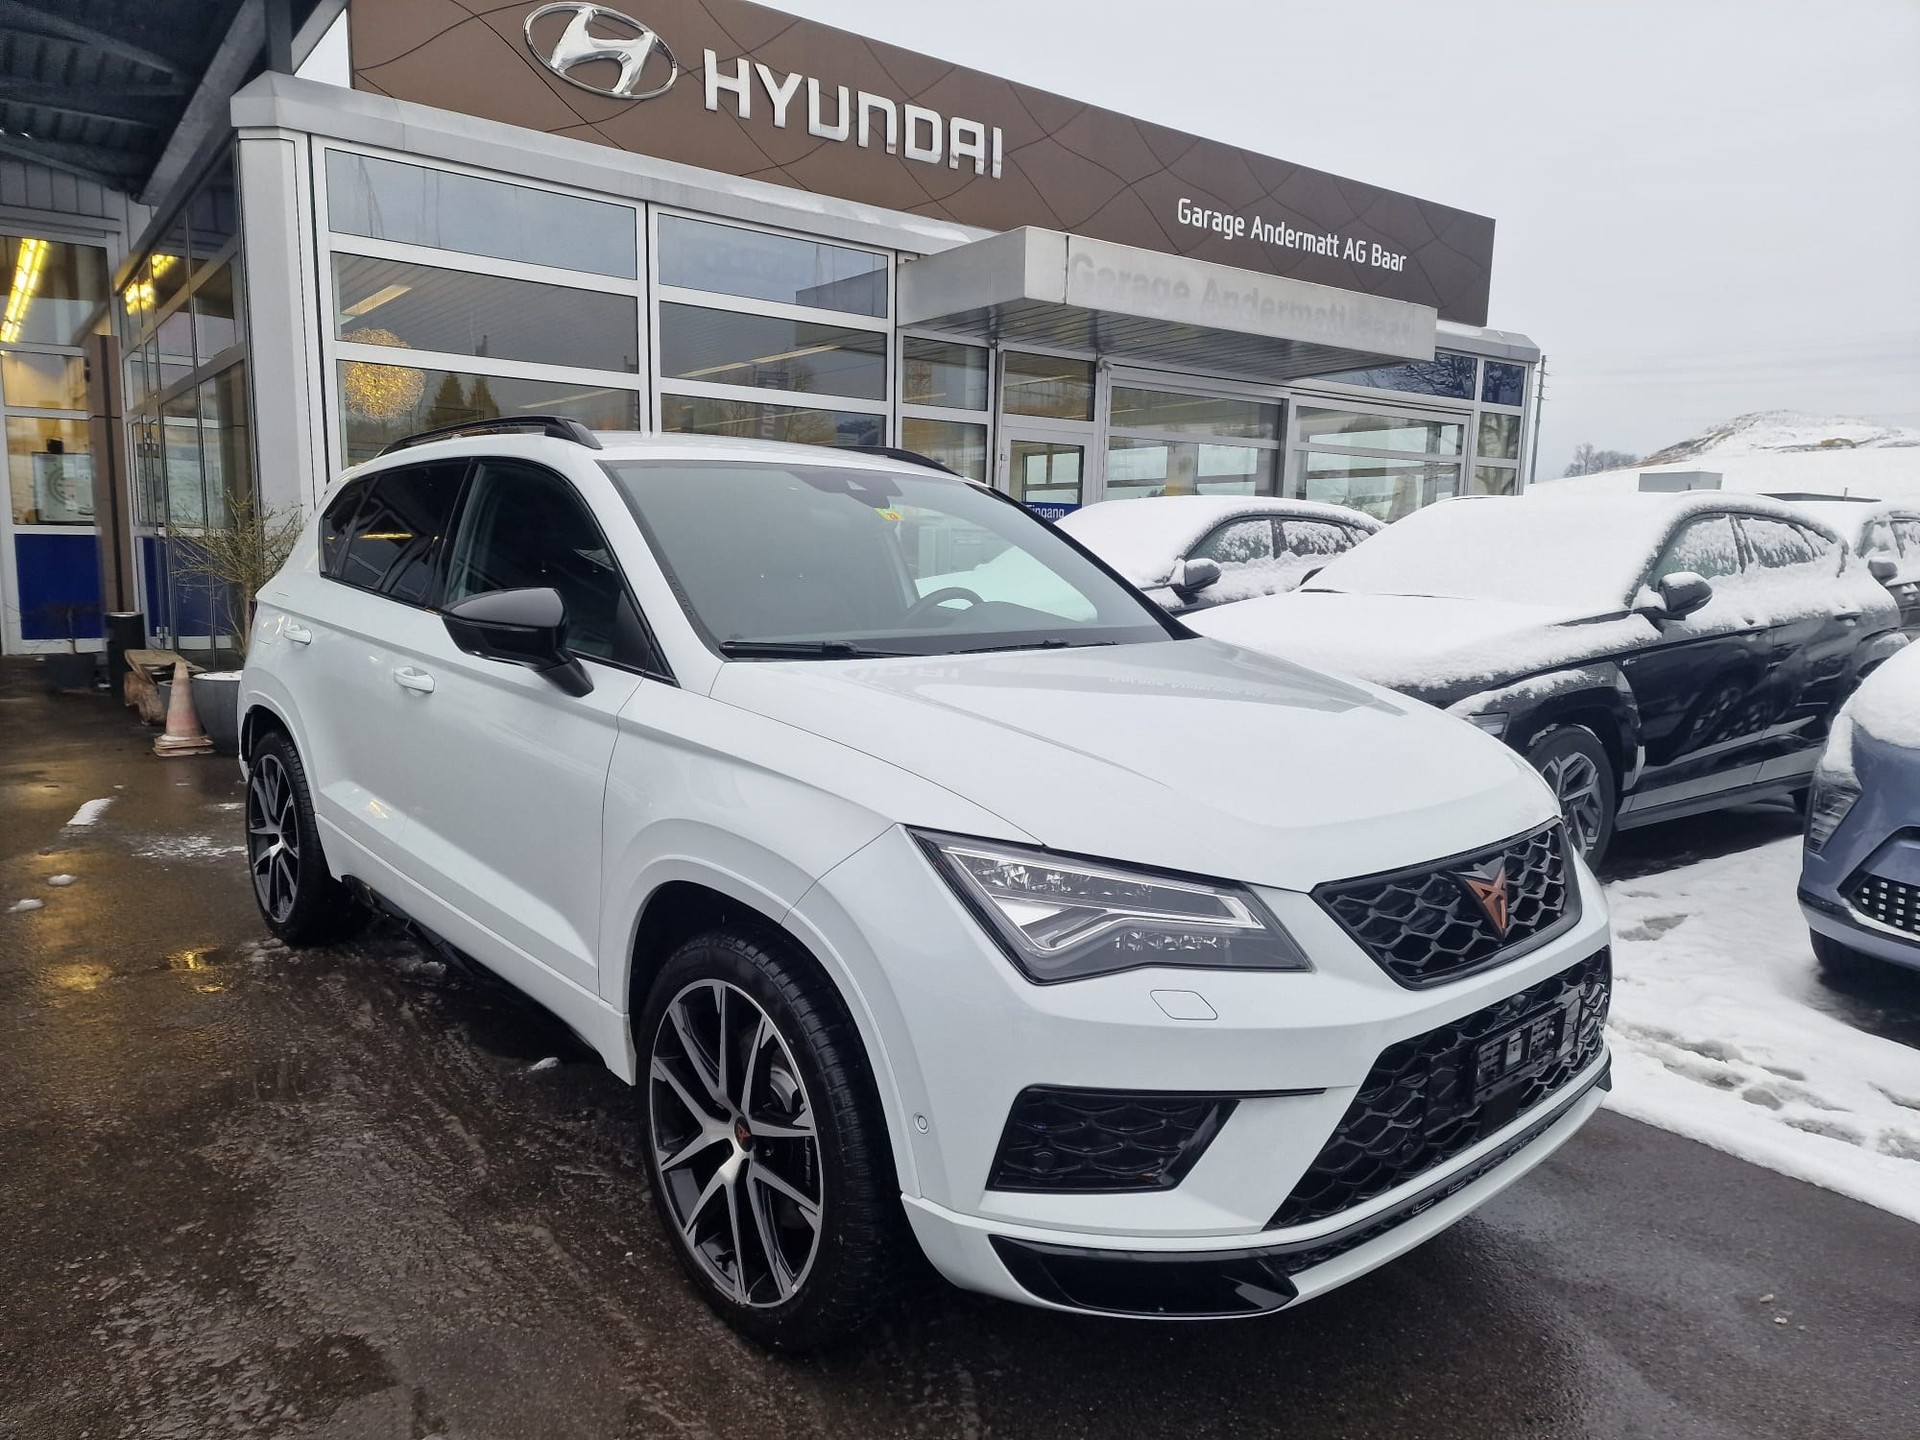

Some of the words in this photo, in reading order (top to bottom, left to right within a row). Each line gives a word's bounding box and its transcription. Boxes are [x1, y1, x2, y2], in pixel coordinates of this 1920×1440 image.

[703, 48, 1002, 179] HYUNDAI
[1177, 198, 1245, 240] Garage
[1250, 215, 1340, 258] Andermatt
[1343, 238, 1367, 264] AG
[1371, 243, 1407, 272] Baar
